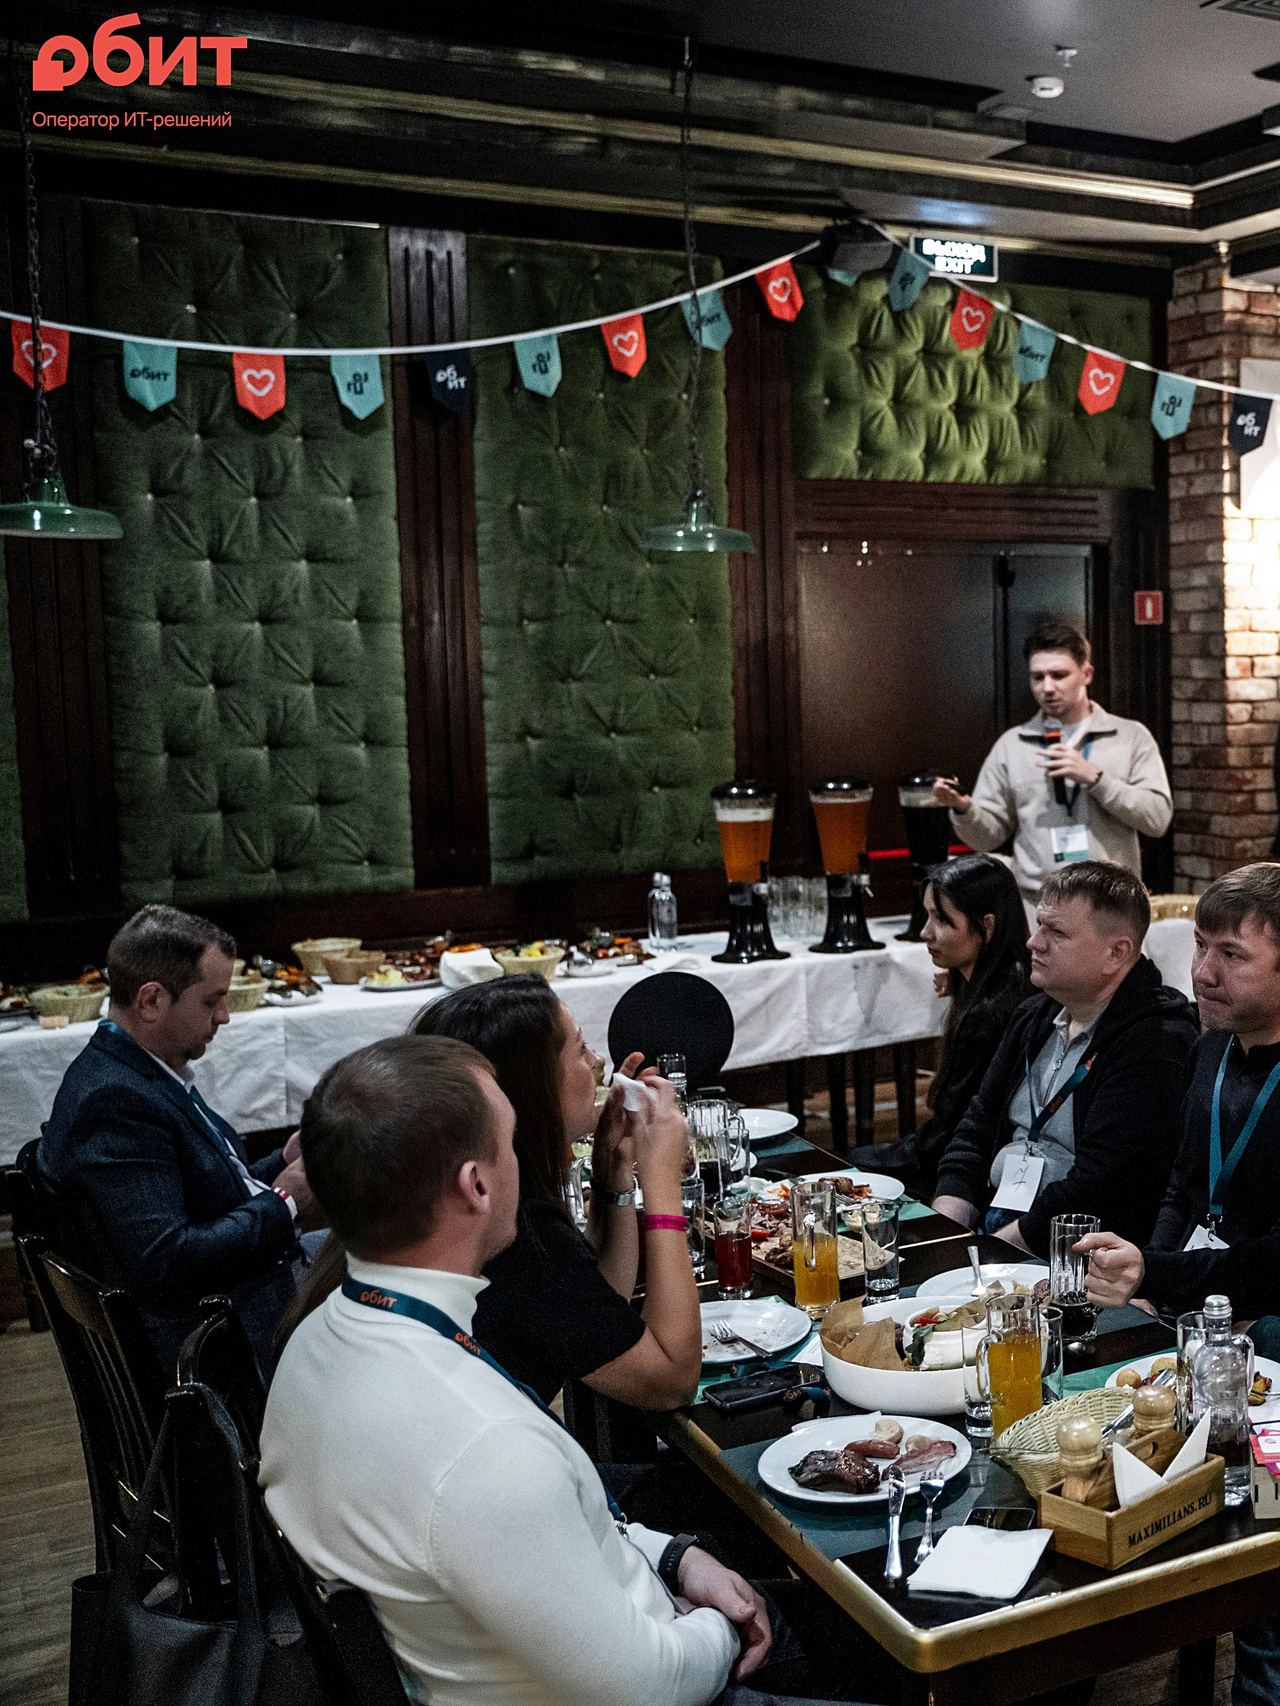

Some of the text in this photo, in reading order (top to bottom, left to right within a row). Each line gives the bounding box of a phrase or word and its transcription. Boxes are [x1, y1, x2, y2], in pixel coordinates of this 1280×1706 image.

[922, 239, 986, 263] ВЫХОД
[935, 256, 974, 274] EXIT
[130, 366, 170, 381] обит
[360, 1289, 397, 1308] обит
[454, 1332, 482, 1356] обит
[1128, 1492, 1213, 1548] MAXIMILIANS.RU
